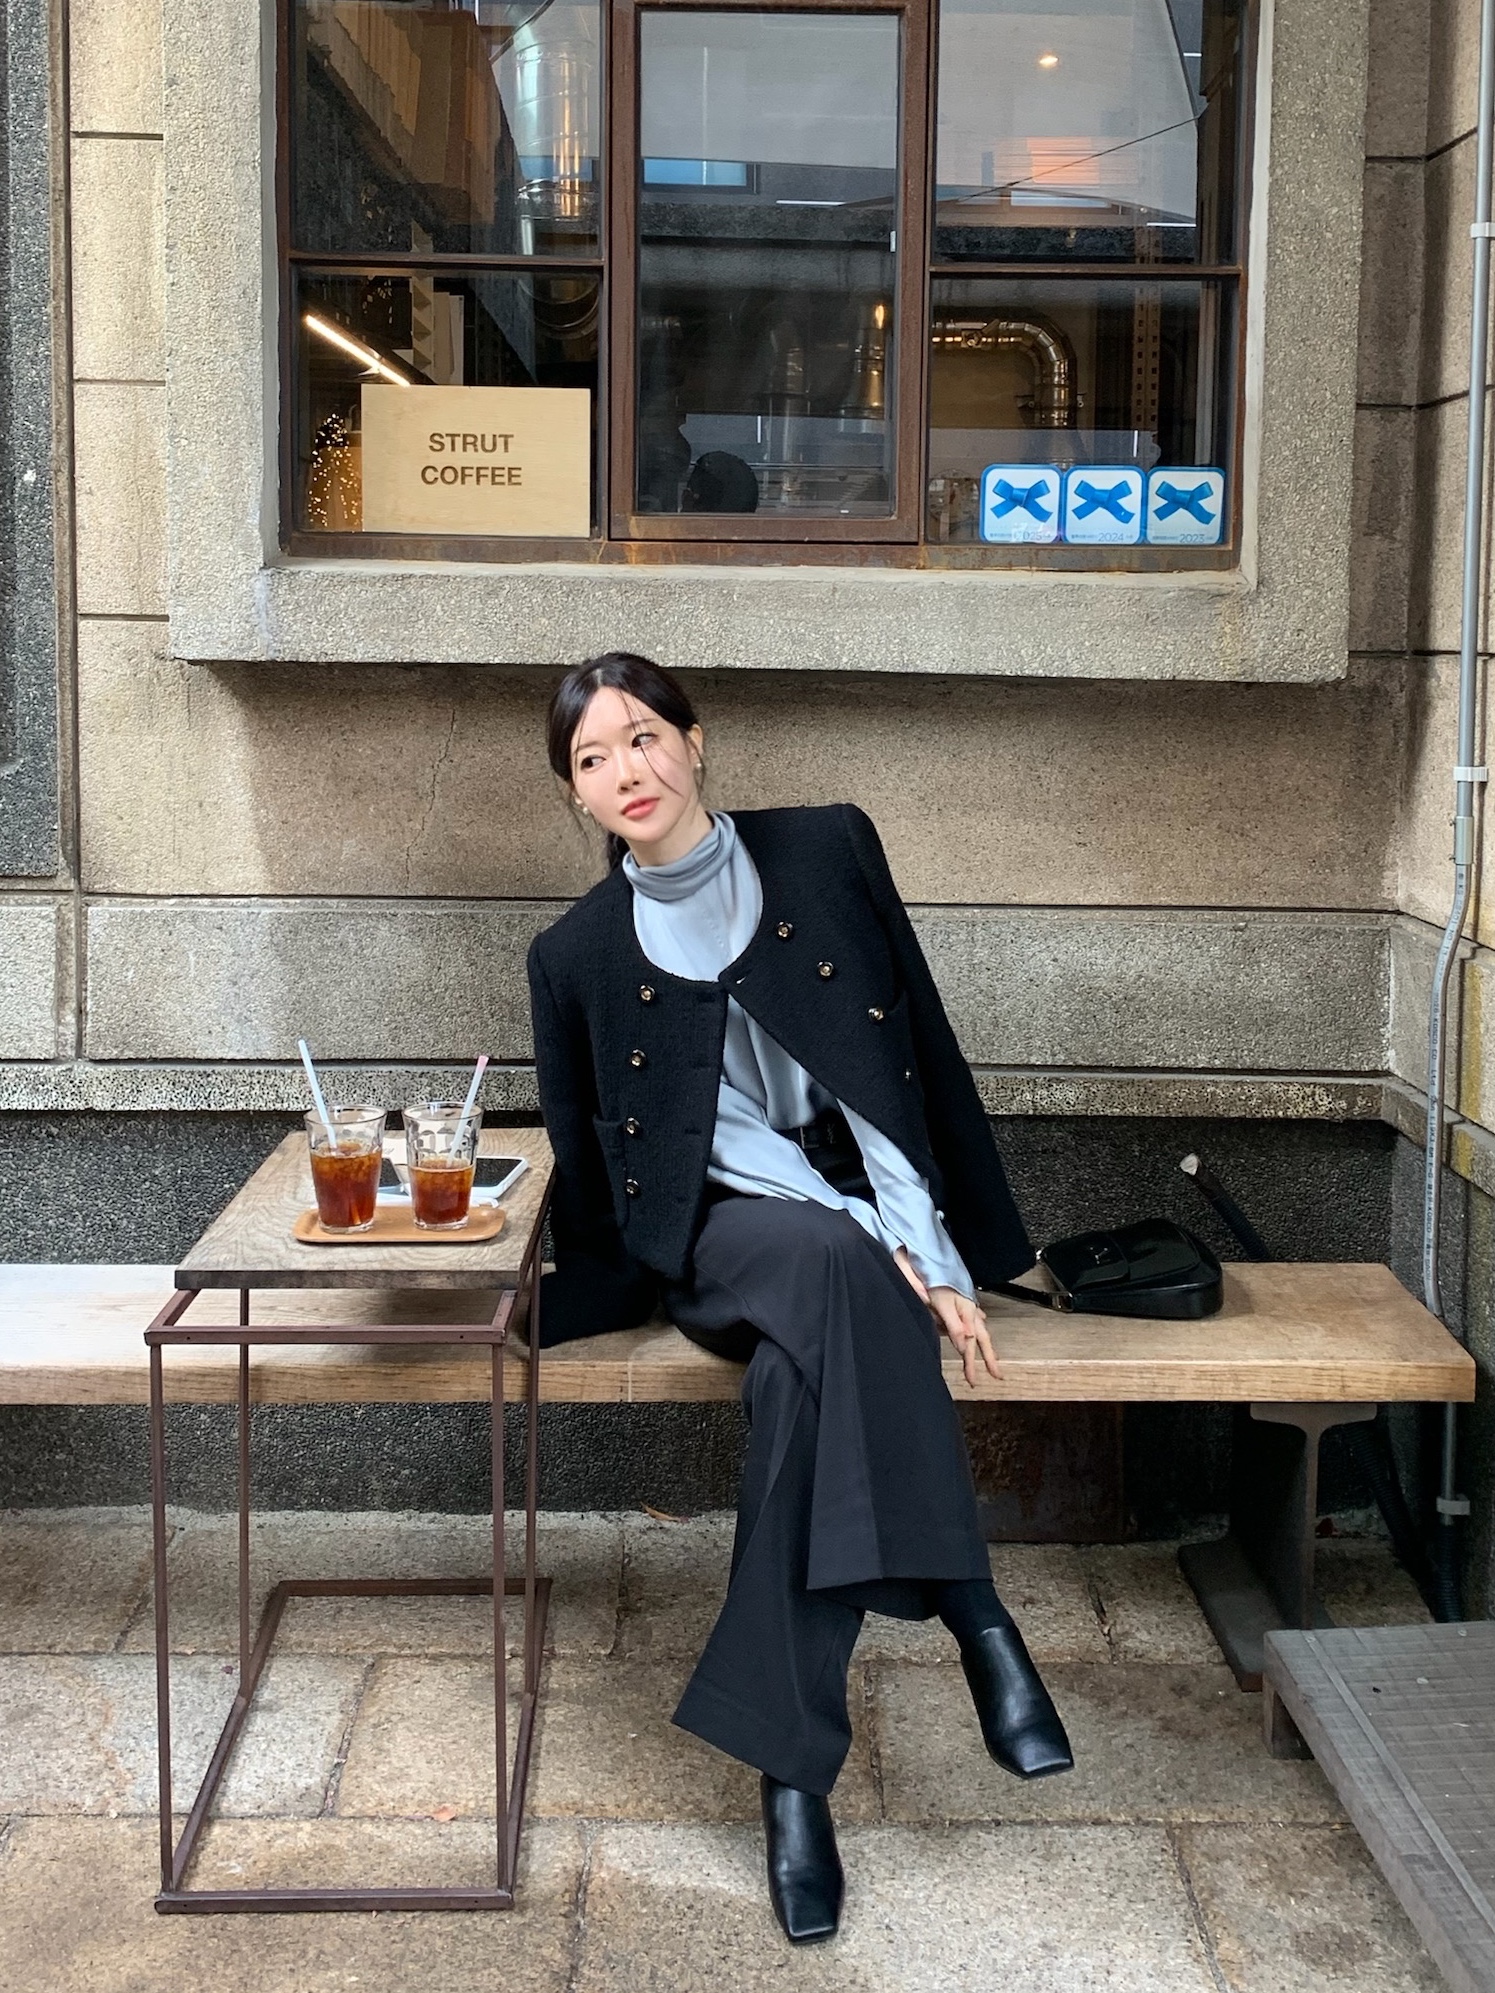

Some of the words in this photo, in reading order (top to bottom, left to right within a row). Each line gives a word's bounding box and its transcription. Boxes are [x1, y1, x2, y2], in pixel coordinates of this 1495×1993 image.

[428, 432, 514, 453] STRUT
[421, 465, 523, 486] COFFEE
[1098, 532, 1124, 542] 2024
[1179, 533, 1205, 543] 2023
